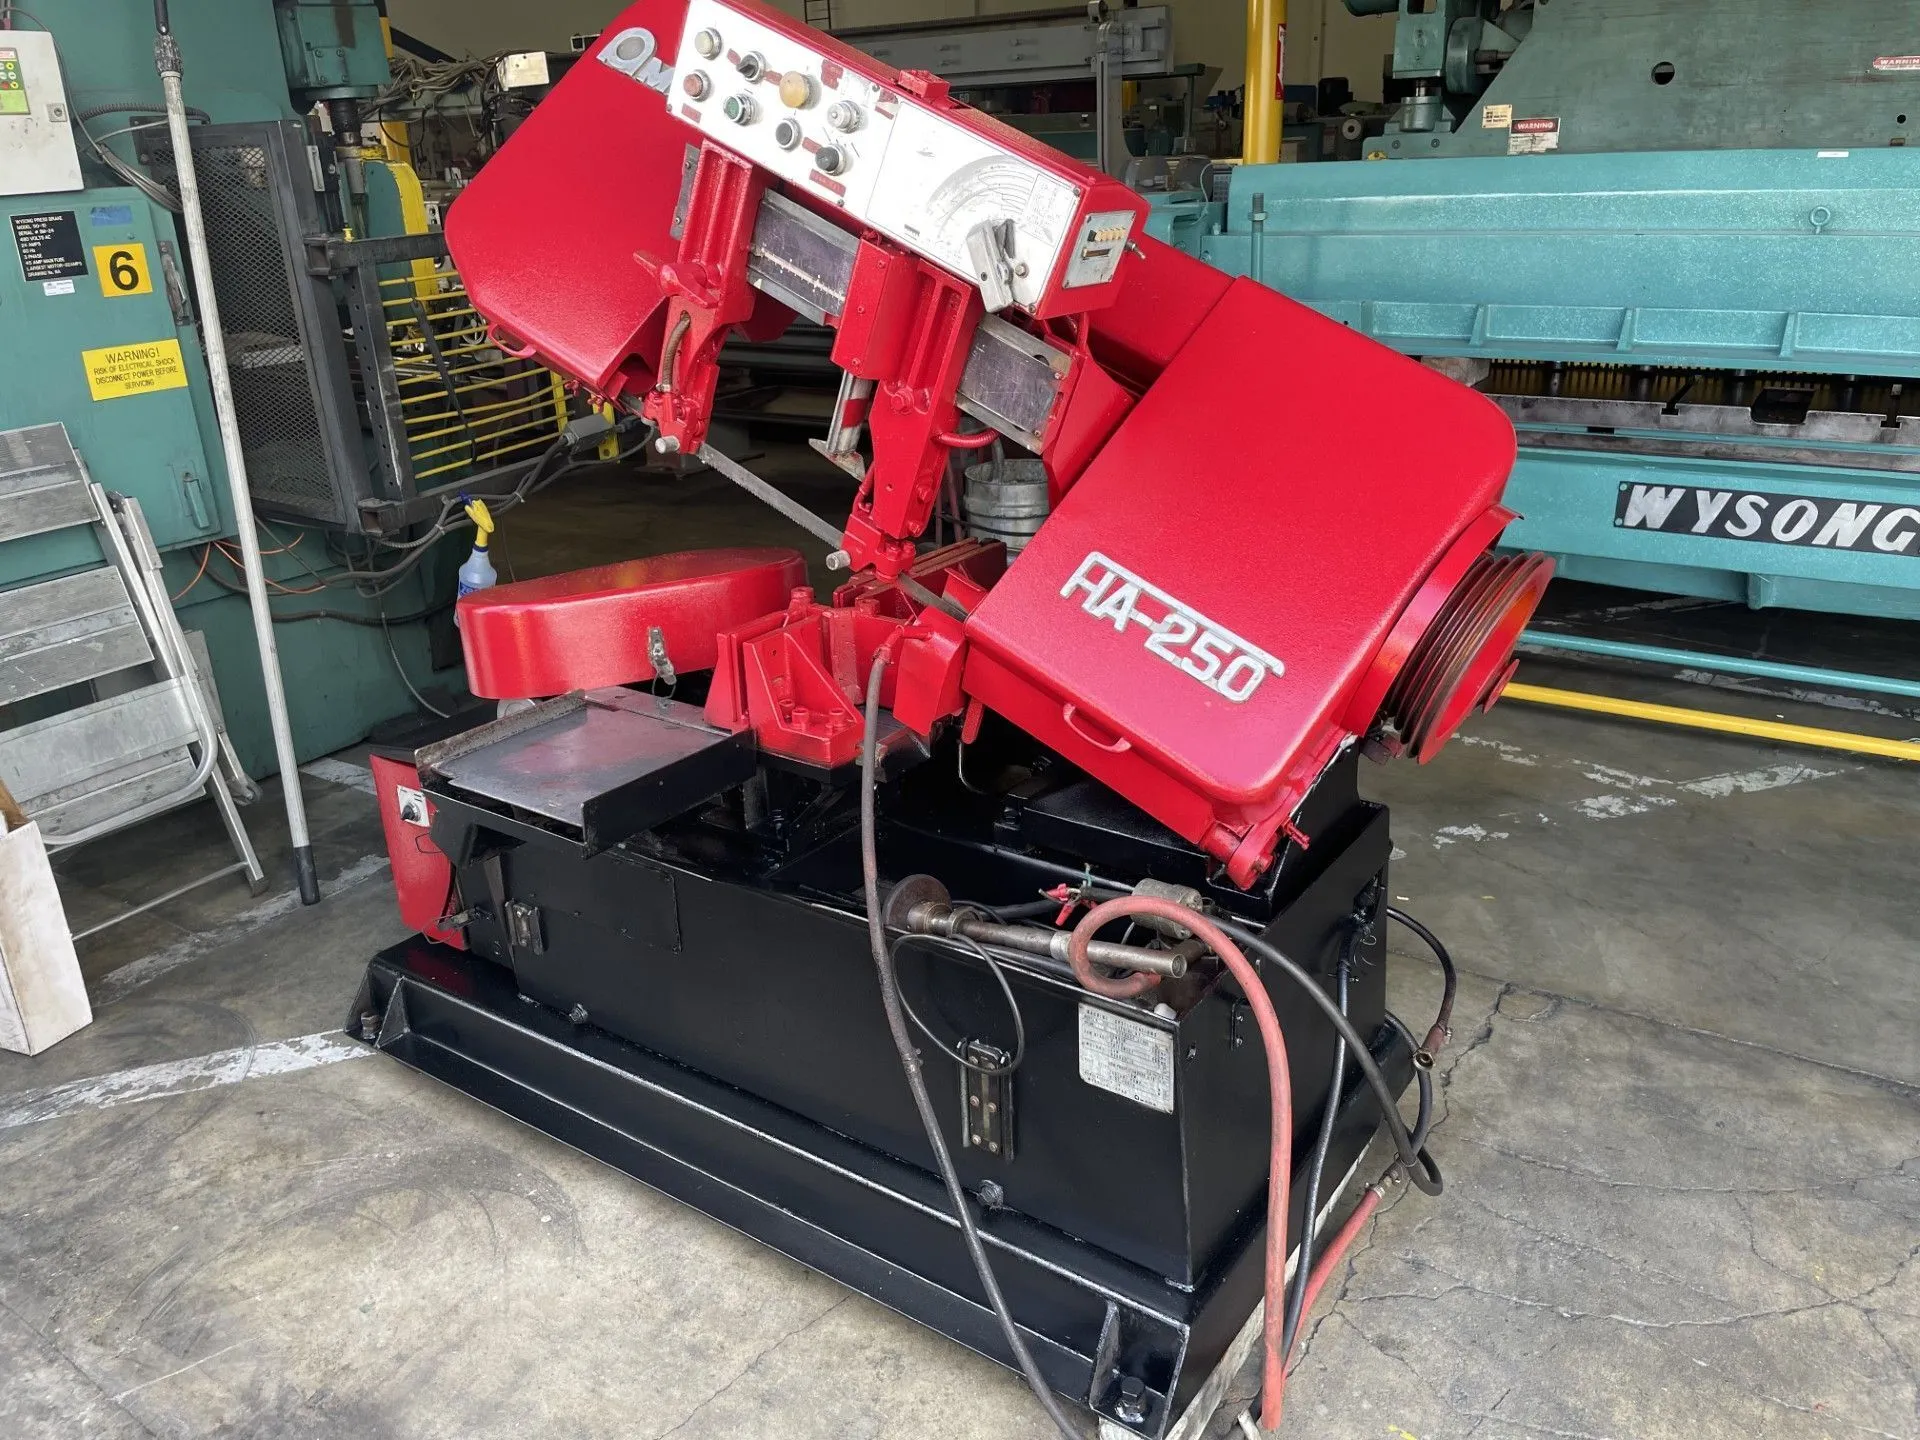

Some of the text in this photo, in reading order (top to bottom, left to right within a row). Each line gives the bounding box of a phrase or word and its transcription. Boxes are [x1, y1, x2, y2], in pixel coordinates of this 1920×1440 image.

[1517, 121, 1554, 131] WARNING
[110, 251, 139, 291] 6
[105, 347, 160, 364] WARNING!
[94, 367, 109, 376] RISK
[119, 361, 155, 372] ELECTRICAL
[156, 357, 176, 367] SHOCK
[95, 365, 179, 385] DISCONNECT POWER BEFORE
[124, 379, 155, 390] SERVICING
[1623, 485, 1920, 552] WYSONG
[1060, 551, 1285, 703] HA-250
